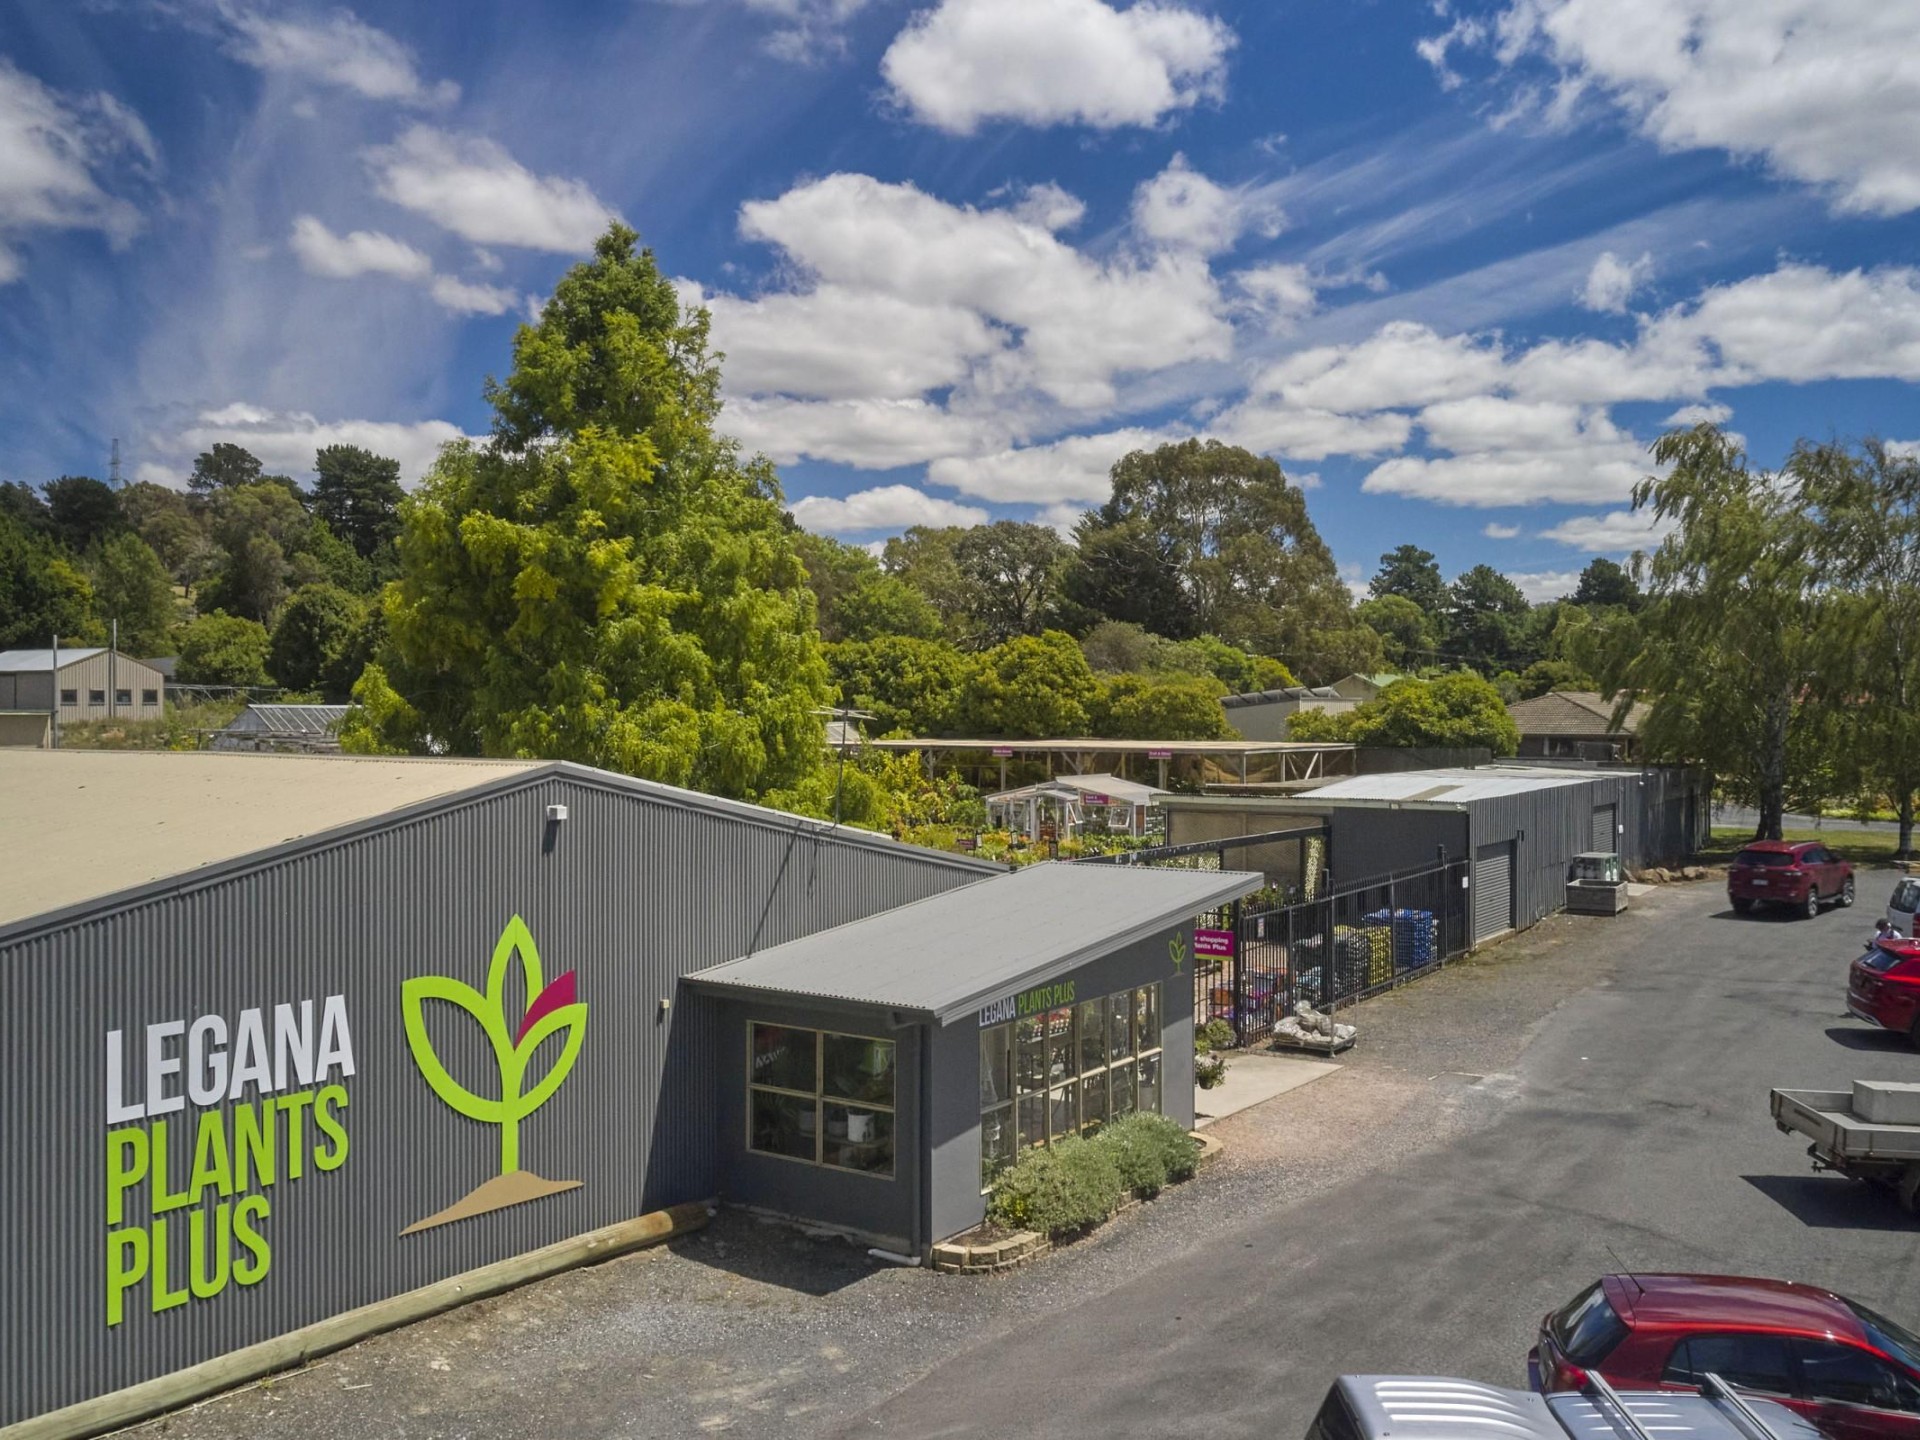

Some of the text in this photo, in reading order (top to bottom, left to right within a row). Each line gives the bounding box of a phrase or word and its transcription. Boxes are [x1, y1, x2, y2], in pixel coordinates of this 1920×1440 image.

[1194, 942, 1211, 950] lants
[1199, 936, 1229, 945] shopping
[979, 980, 1075, 1027] LEGANA PLANTS PLUS
[106, 994, 355, 1125] LEGANA
[107, 1084, 349, 1226] PLANTS
[107, 1194, 271, 1326] PLUS
